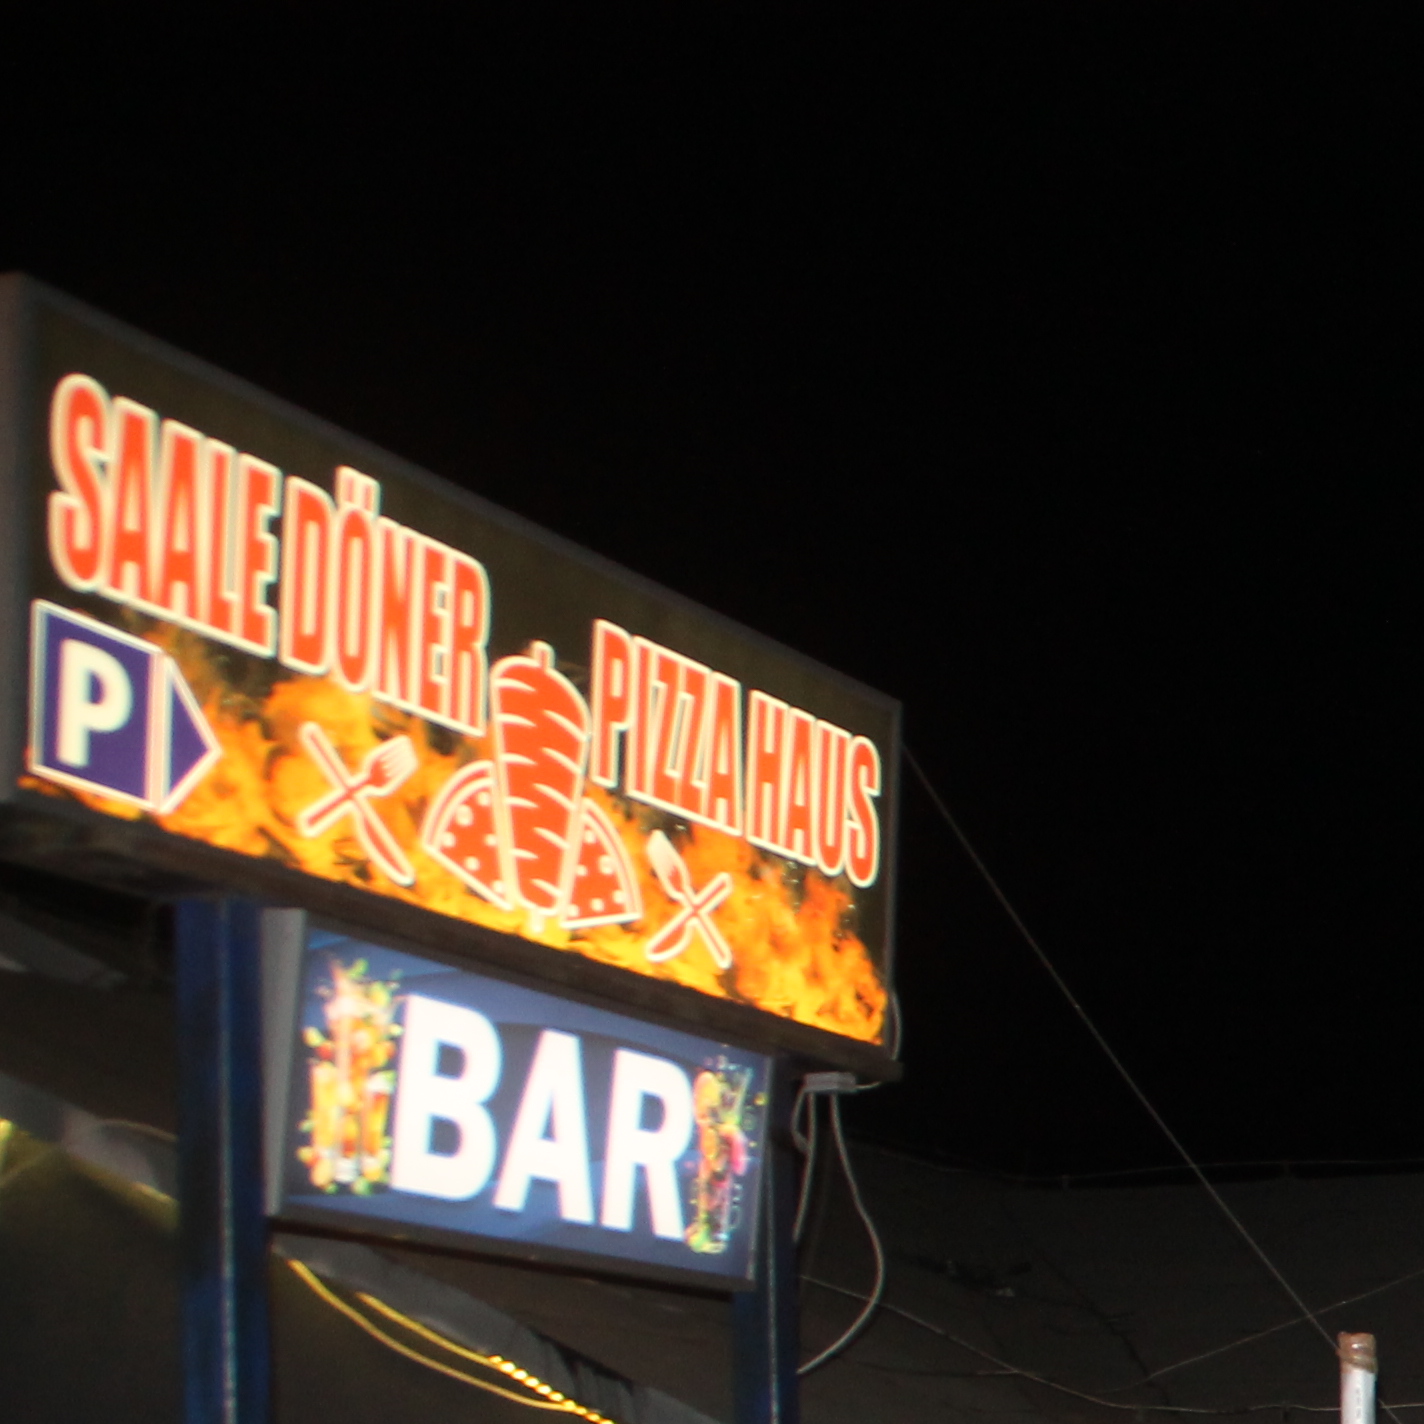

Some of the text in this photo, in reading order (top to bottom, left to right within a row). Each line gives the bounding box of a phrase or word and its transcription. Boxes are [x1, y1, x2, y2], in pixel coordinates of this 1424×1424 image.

[49, 374, 882, 888] SAALE DÖNER PIZZA HAUS
[56, 637, 134, 768] P
[389, 992, 695, 1242] BAR
